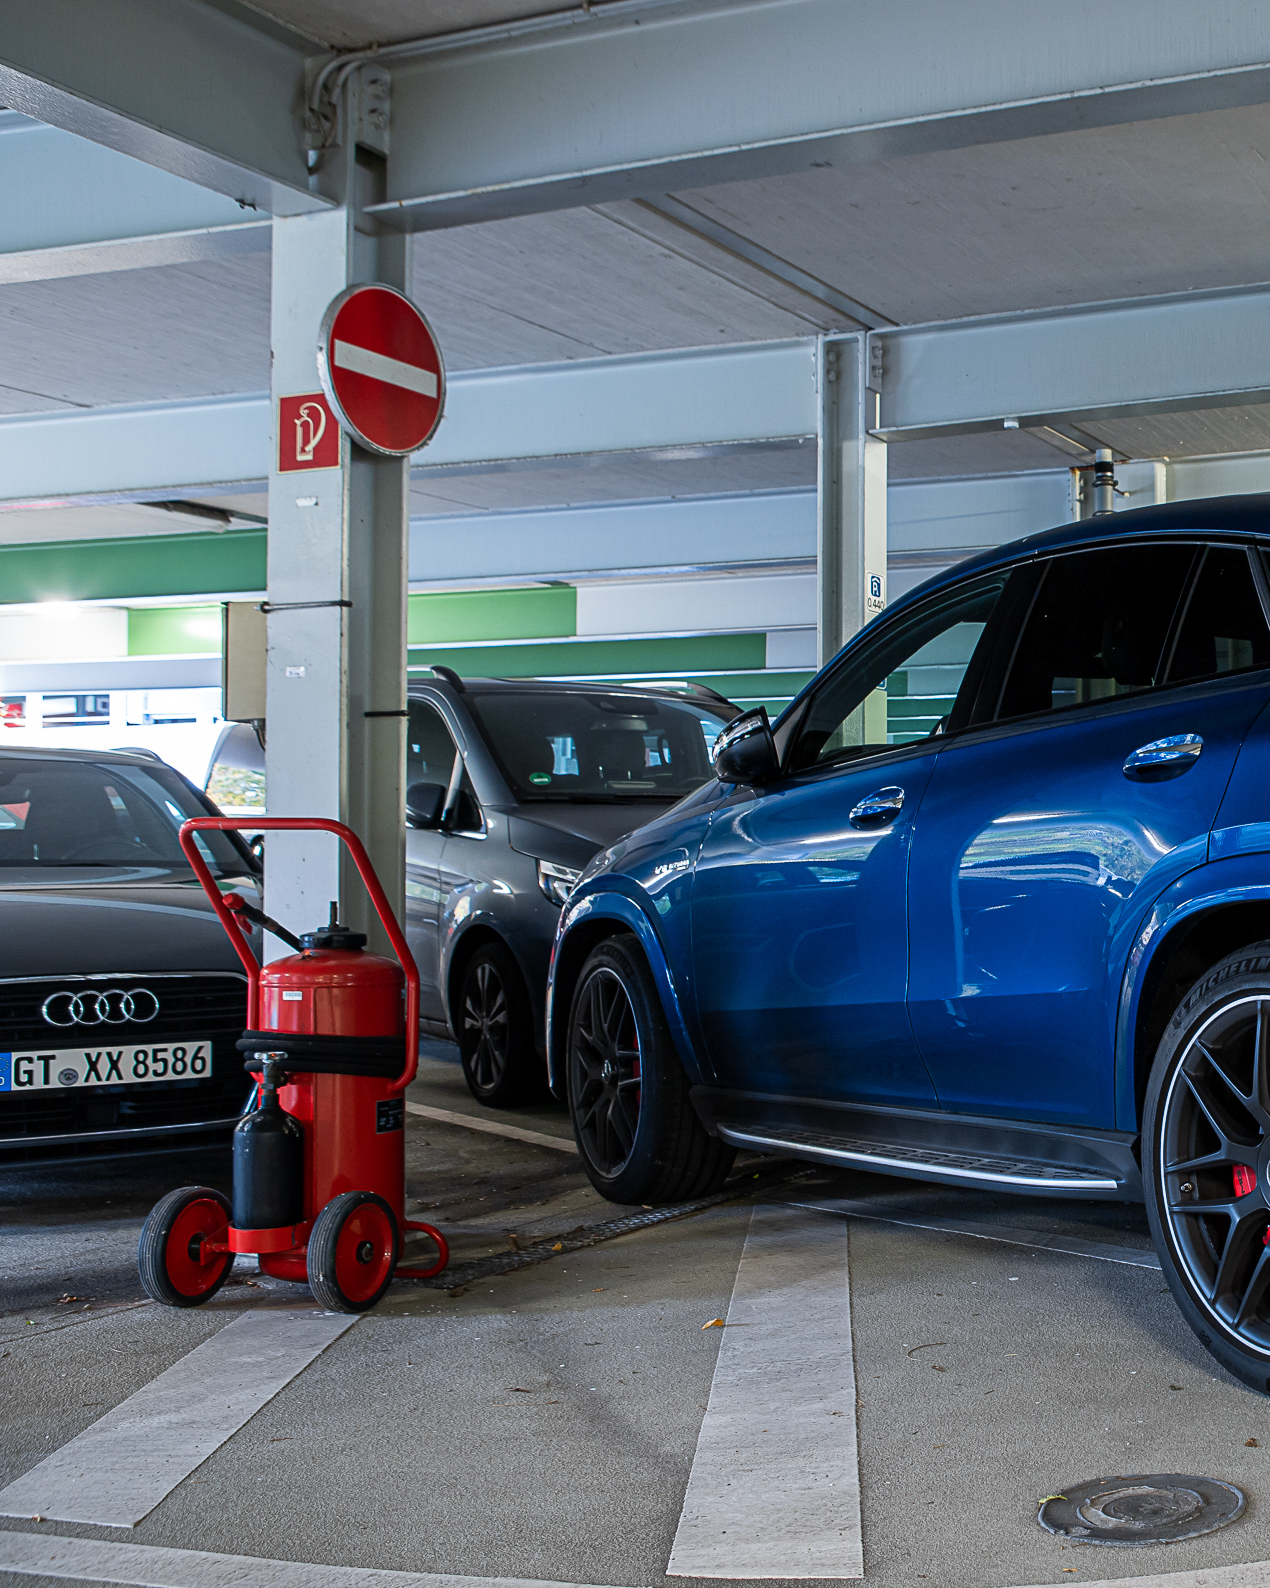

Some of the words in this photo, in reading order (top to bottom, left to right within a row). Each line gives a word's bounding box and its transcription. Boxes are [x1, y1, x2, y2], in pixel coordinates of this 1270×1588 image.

[13, 1053, 56, 1087] GT
[83, 1050, 124, 1082] XX
[132, 1045, 207, 1079] 8586
